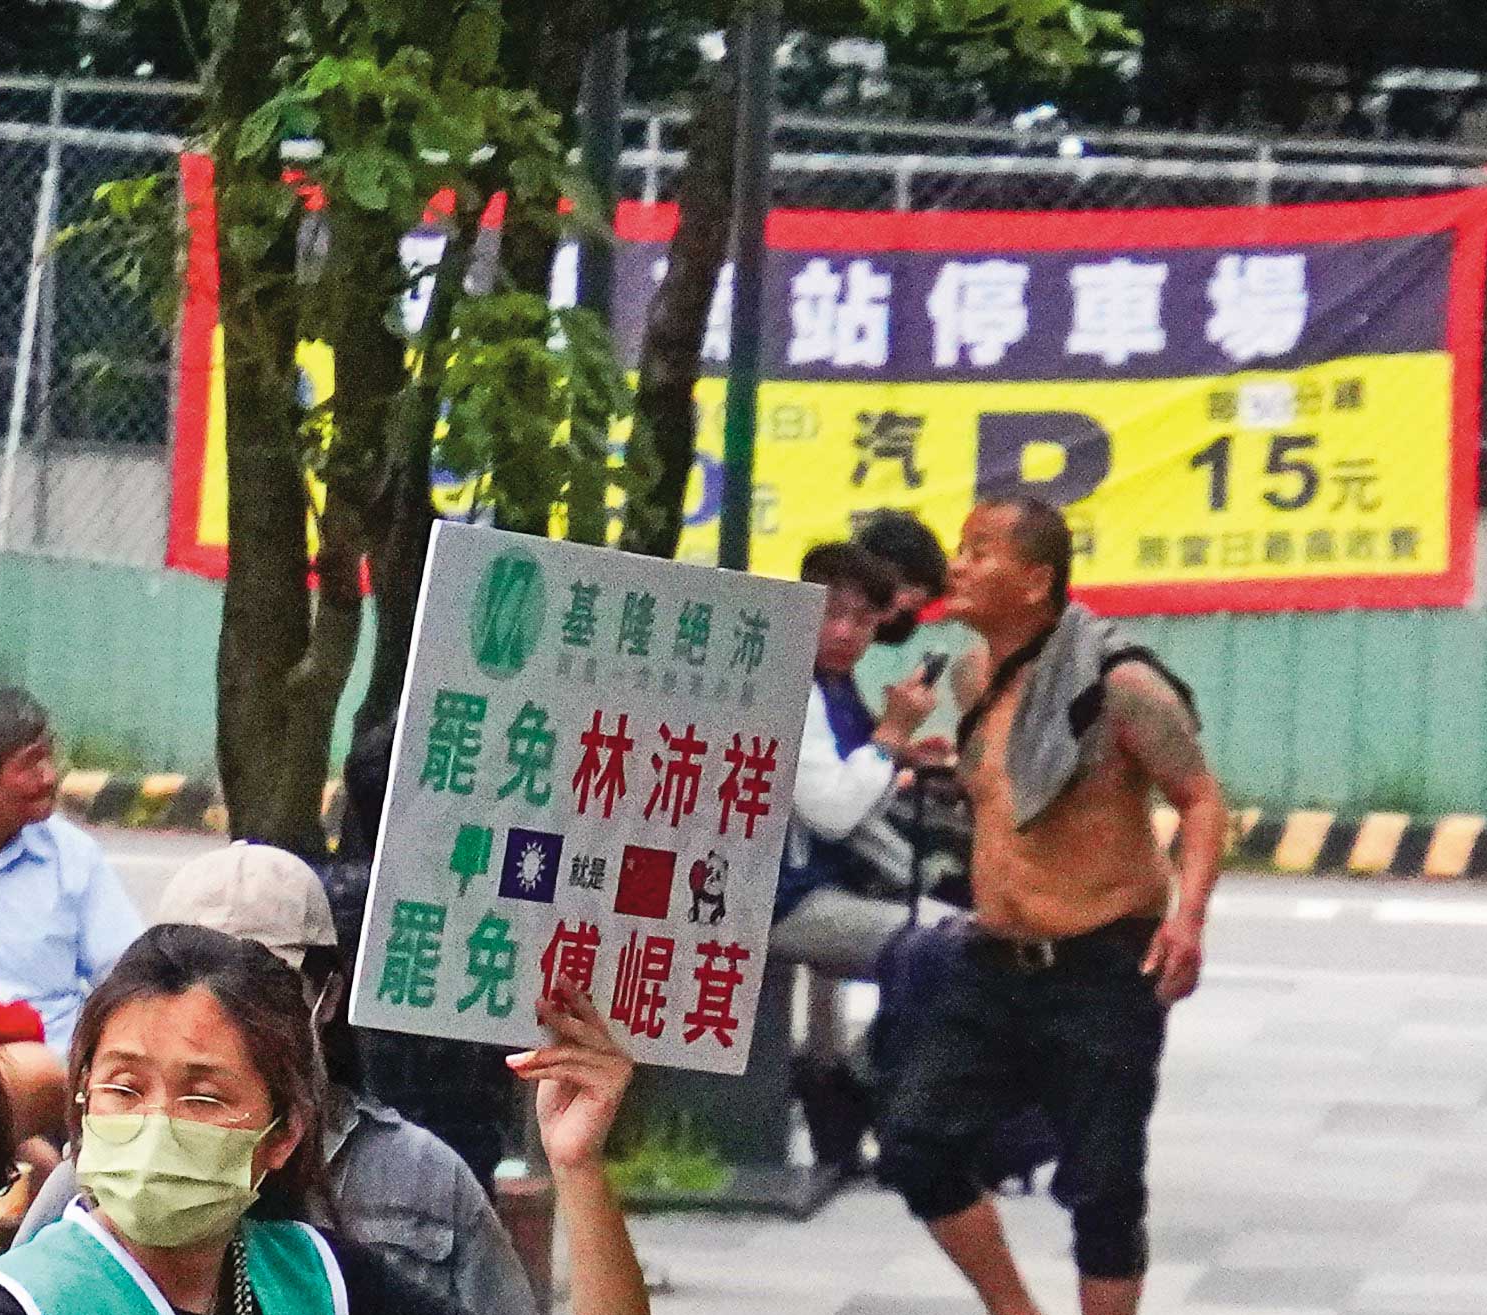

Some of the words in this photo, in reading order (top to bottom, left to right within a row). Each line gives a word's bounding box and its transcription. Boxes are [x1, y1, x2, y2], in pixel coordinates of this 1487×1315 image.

[702, 254, 1309, 368] 站停車場
[1190, 433, 1382, 513] 15元
[419, 687, 780, 840] 罷免林沛祥
[568, 852, 609, 892] 就是
